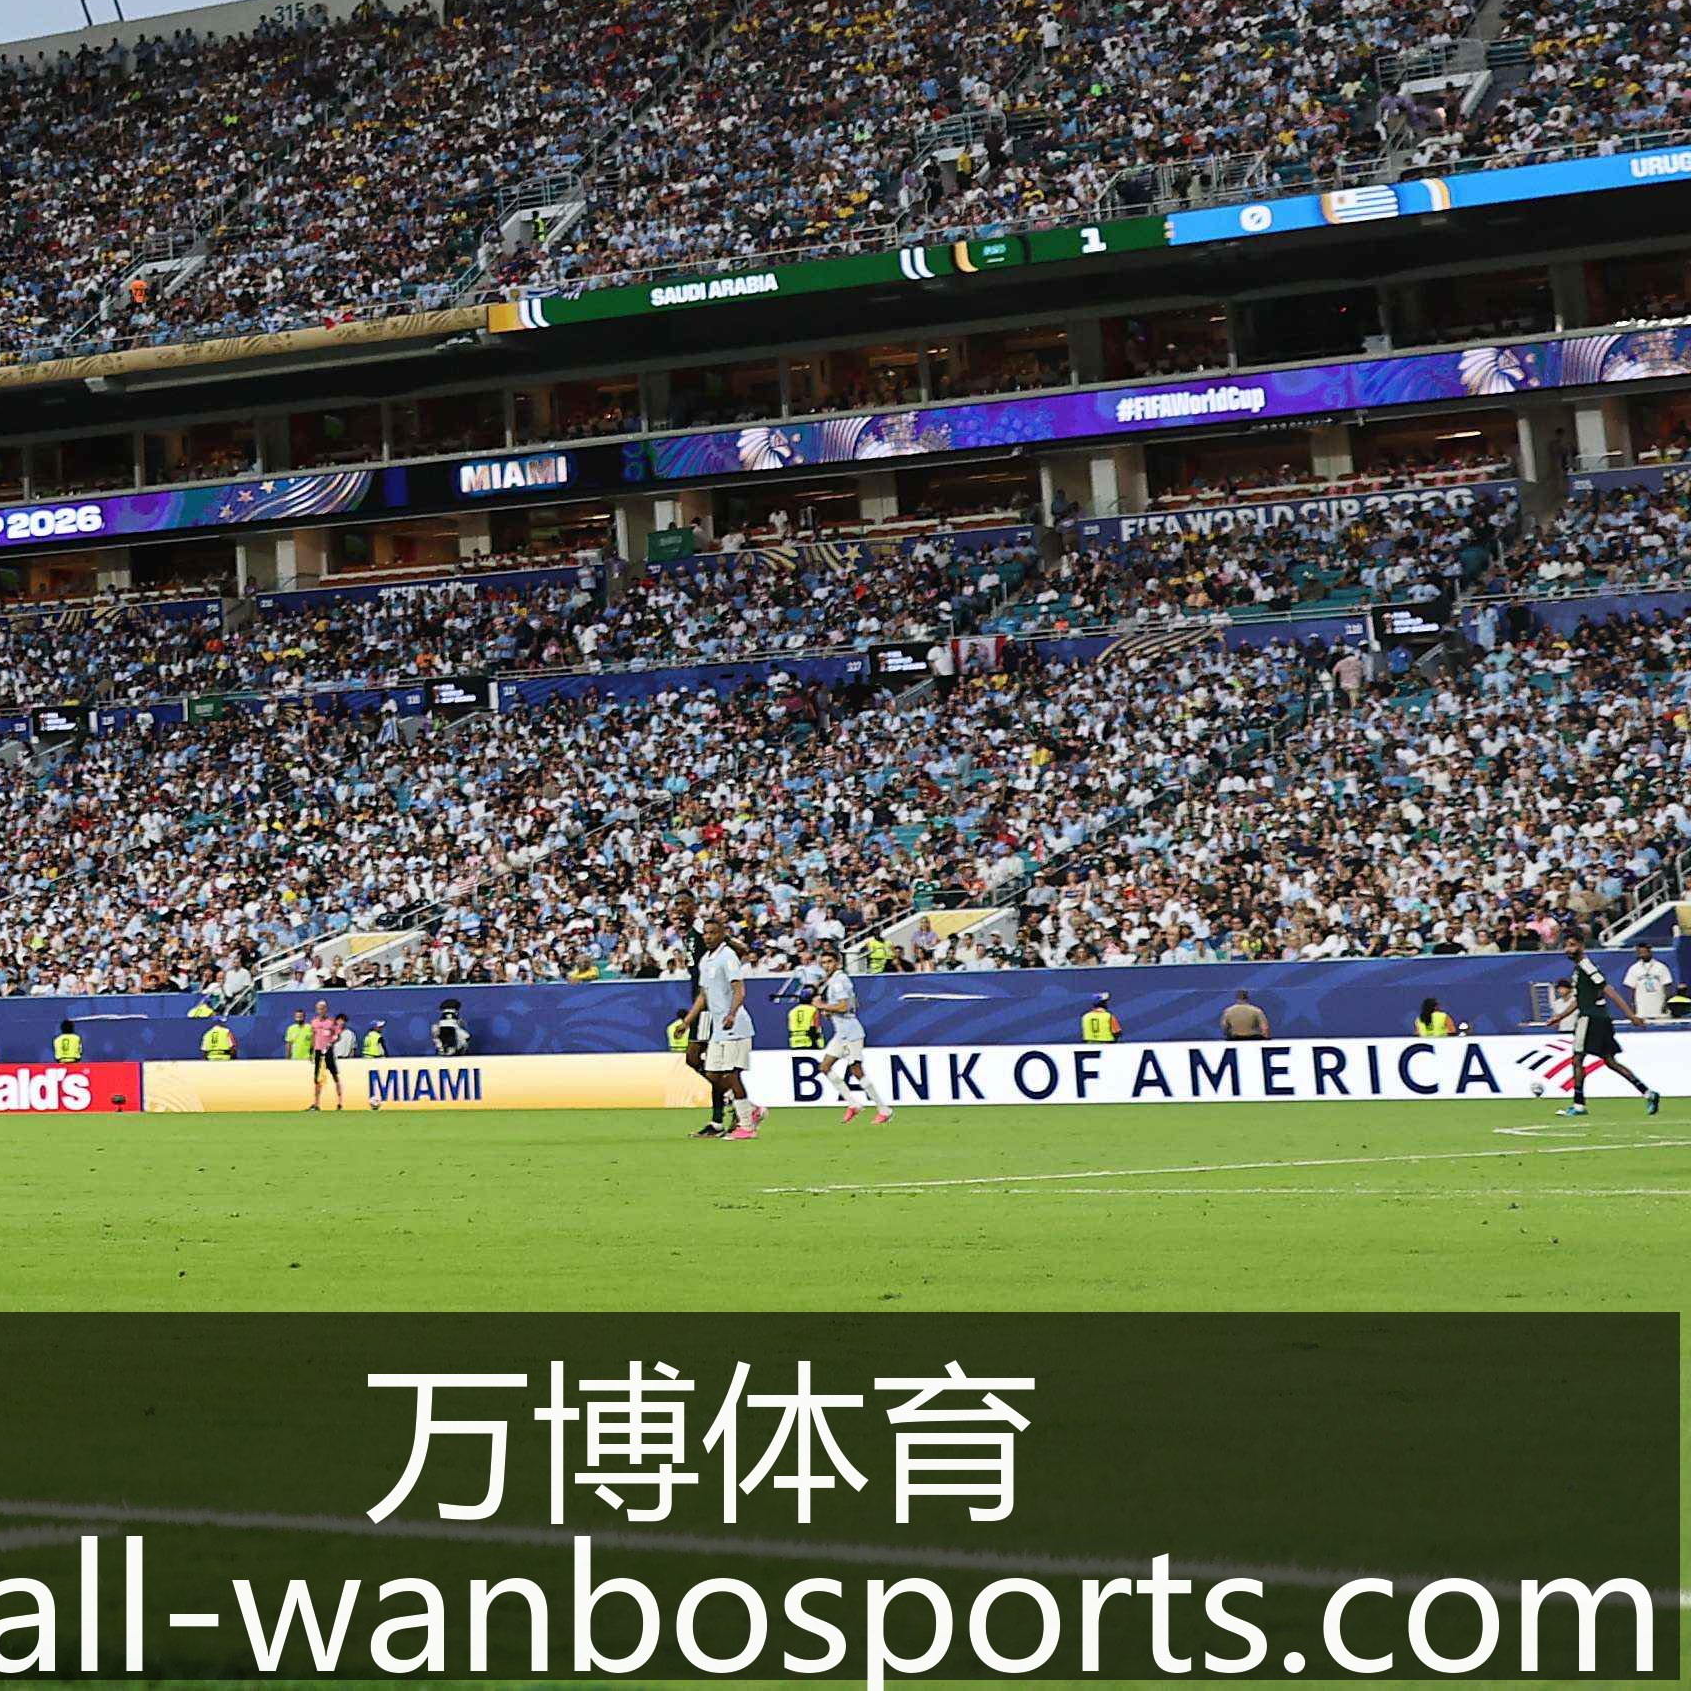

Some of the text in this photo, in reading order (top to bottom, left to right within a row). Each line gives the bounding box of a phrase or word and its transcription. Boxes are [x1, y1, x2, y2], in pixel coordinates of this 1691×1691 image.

[274, 2, 306, 23] 315
[1080, 227, 1107, 254] 1
[650, 273, 779, 307] SAUDI ARABIA
[1115, 386, 1266, 422] #FIFAWorldCup
[460, 455, 568, 493] MIAMI
[6, 504, 103, 540] 2026
[1121, 516, 1183, 542] FIFA
[368, 1068, 482, 1102] MIAMI
[1013, 1050, 1103, 1100] OF
[1131, 1043, 1502, 1097] AMERICA
